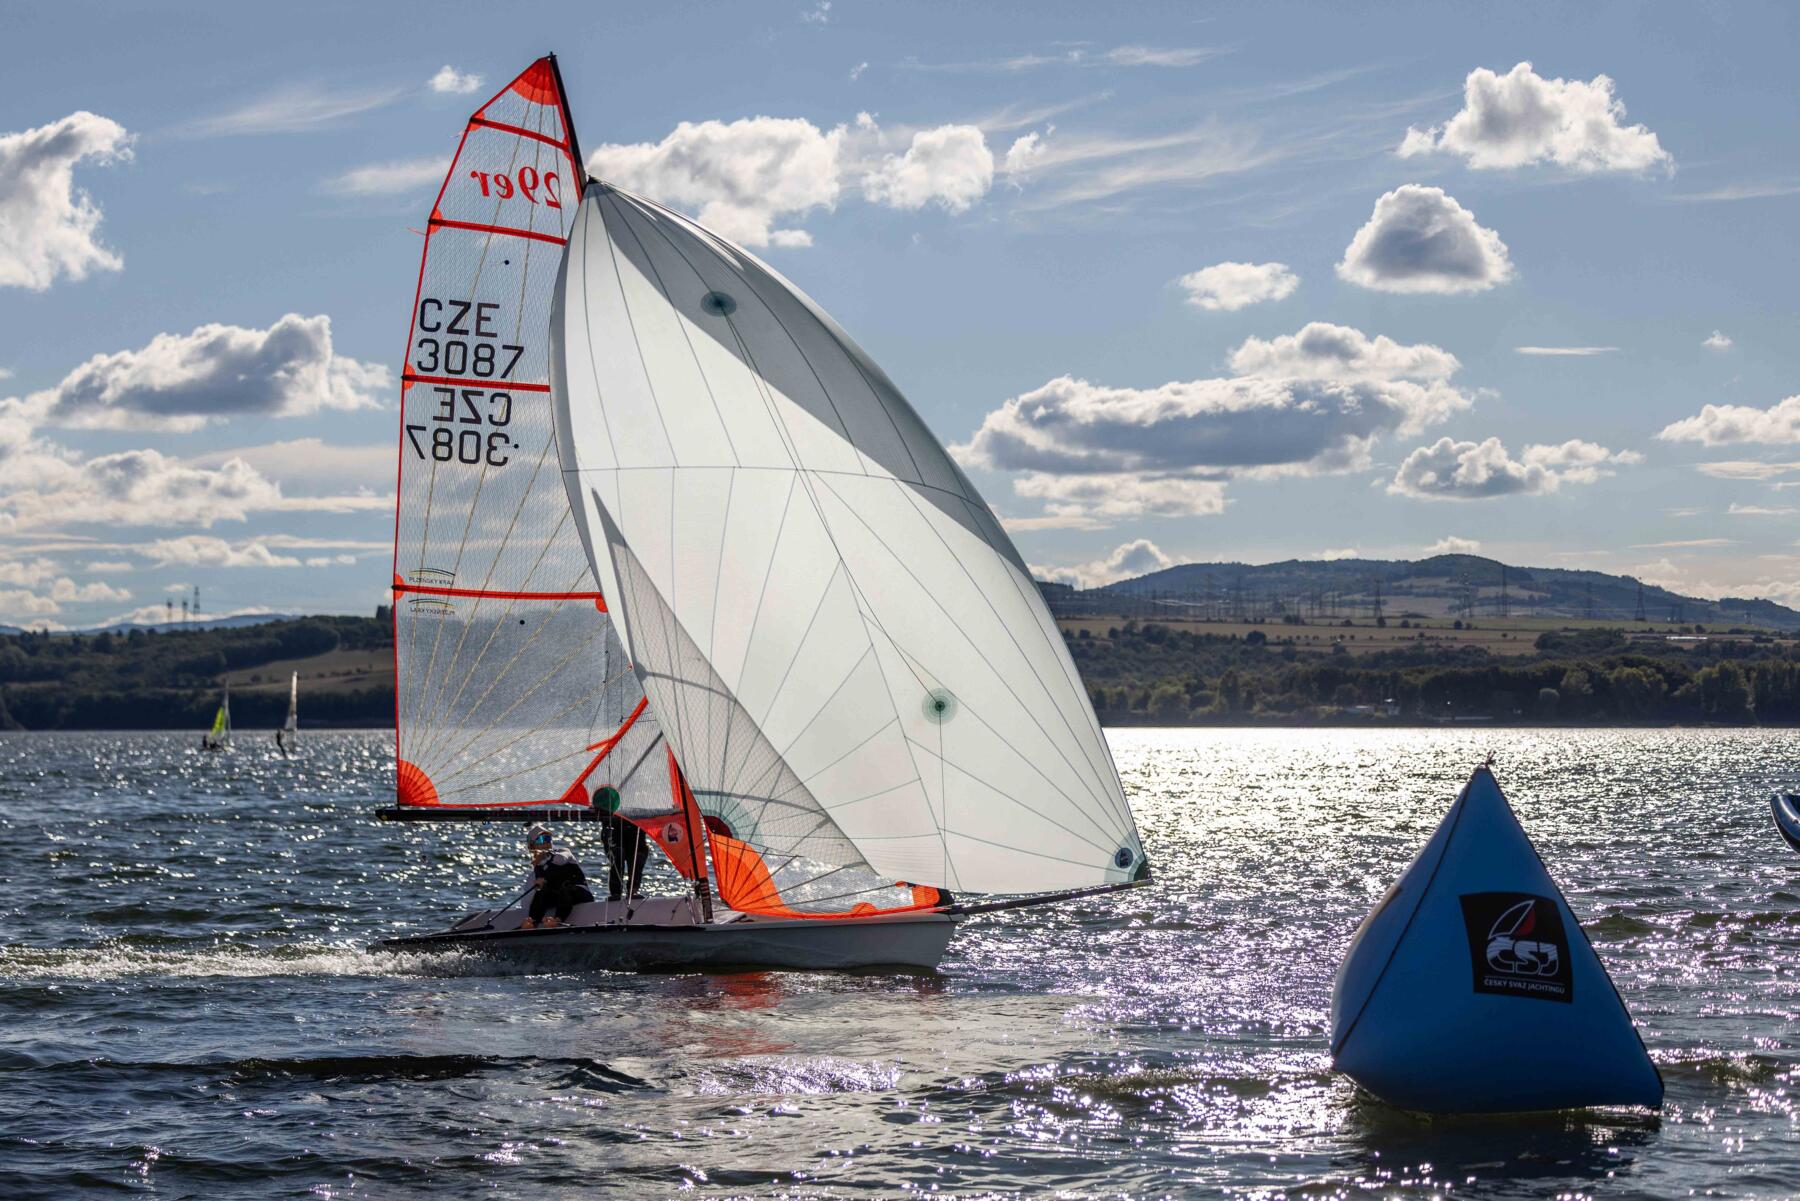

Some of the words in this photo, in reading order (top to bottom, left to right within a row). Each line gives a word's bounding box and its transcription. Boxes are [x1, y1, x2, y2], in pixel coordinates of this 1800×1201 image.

[419, 298, 500, 338] CZE
[416, 338, 524, 379] 3087
[1508, 980, 1527, 990] SVAZ
[1527, 983, 1566, 995] JACHTINGU
